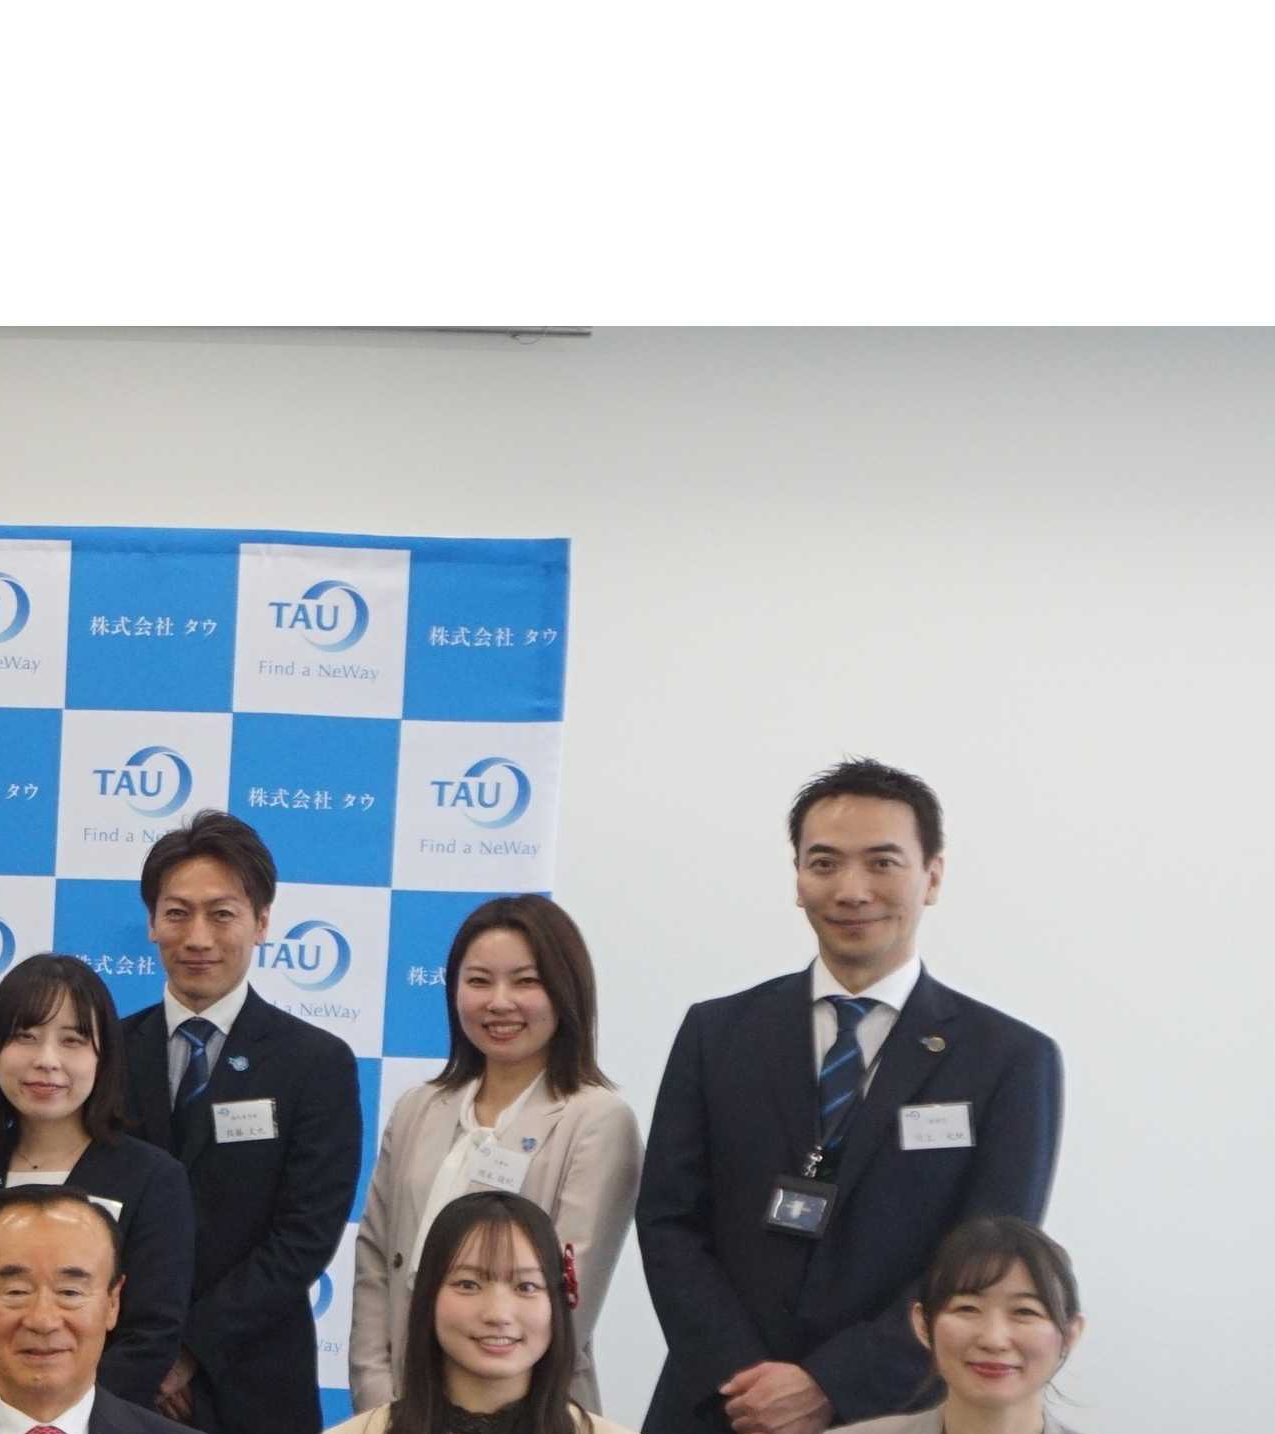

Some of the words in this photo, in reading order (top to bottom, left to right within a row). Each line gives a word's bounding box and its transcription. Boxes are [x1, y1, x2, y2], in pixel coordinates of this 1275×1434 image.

[90, 616, 173, 636] 株式会社
[186, 619, 217, 635] タウ
[269, 602, 338, 631] TAU
[430, 626, 513, 646] 株式会社
[526, 628, 557, 644] タウ
[257, 660, 295, 676] Find
[302, 666, 310, 676] a
[318, 664, 378, 681] NeWay
[7, 784, 38, 799] タウ
[93, 770, 162, 797] TAU
[249, 788, 331, 809] 株式会社
[344, 794, 374, 809] タウ
[431, 781, 500, 808] TAU
[82, 828, 119, 841] Find
[126, 832, 134, 842] a
[418, 839, 456, 853] Find
[463, 844, 472, 854] a
[480, 840, 537, 855] NeWay
[255, 943, 321, 971] TAU
[300, 1003, 361, 1022] NeWay
